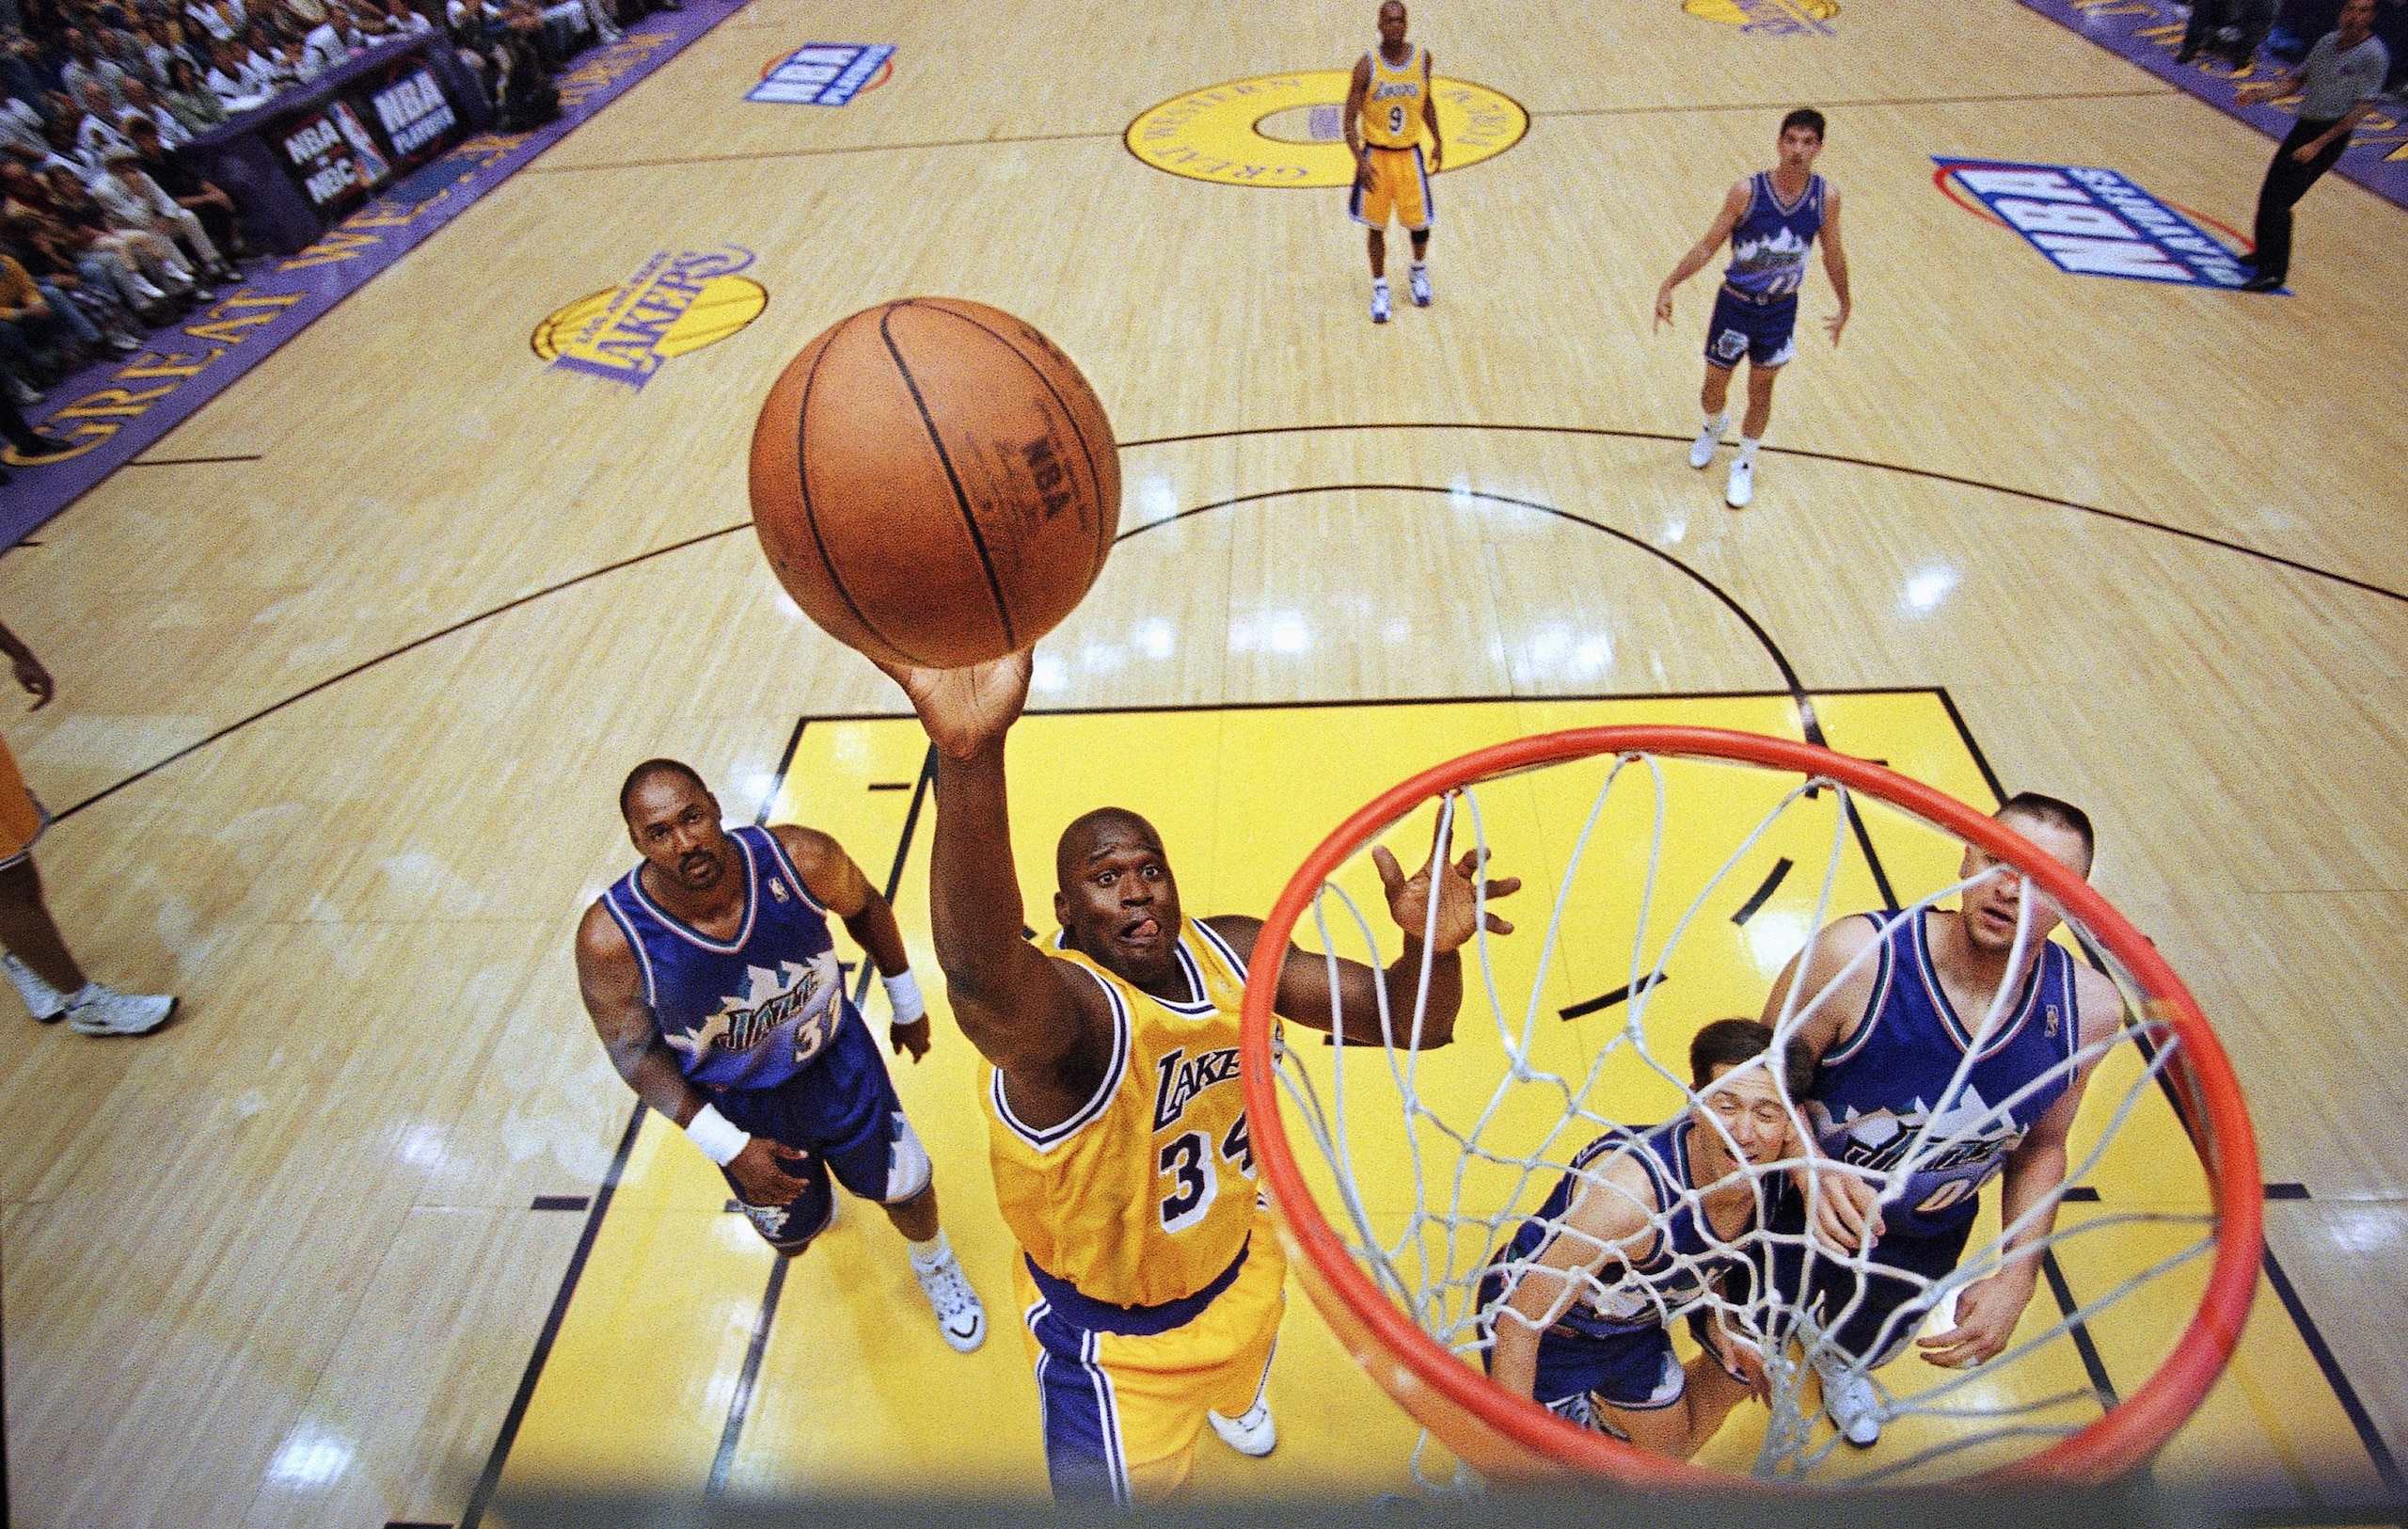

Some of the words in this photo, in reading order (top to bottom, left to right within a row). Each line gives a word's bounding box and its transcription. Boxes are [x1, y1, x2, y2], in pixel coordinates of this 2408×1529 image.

[284, 117, 342, 166] NBA
[372, 69, 447, 134] NBA
[1389, 104, 1405, 135] 9
[304, 157, 356, 205] NBC
[1953, 168, 2197, 280] NBA
[545, 241, 756, 394] LAKERS
[1020, 435, 1071, 522] NBA
[1152, 1044, 1247, 1133] LAKE
[1159, 1107, 1257, 1234] 34
